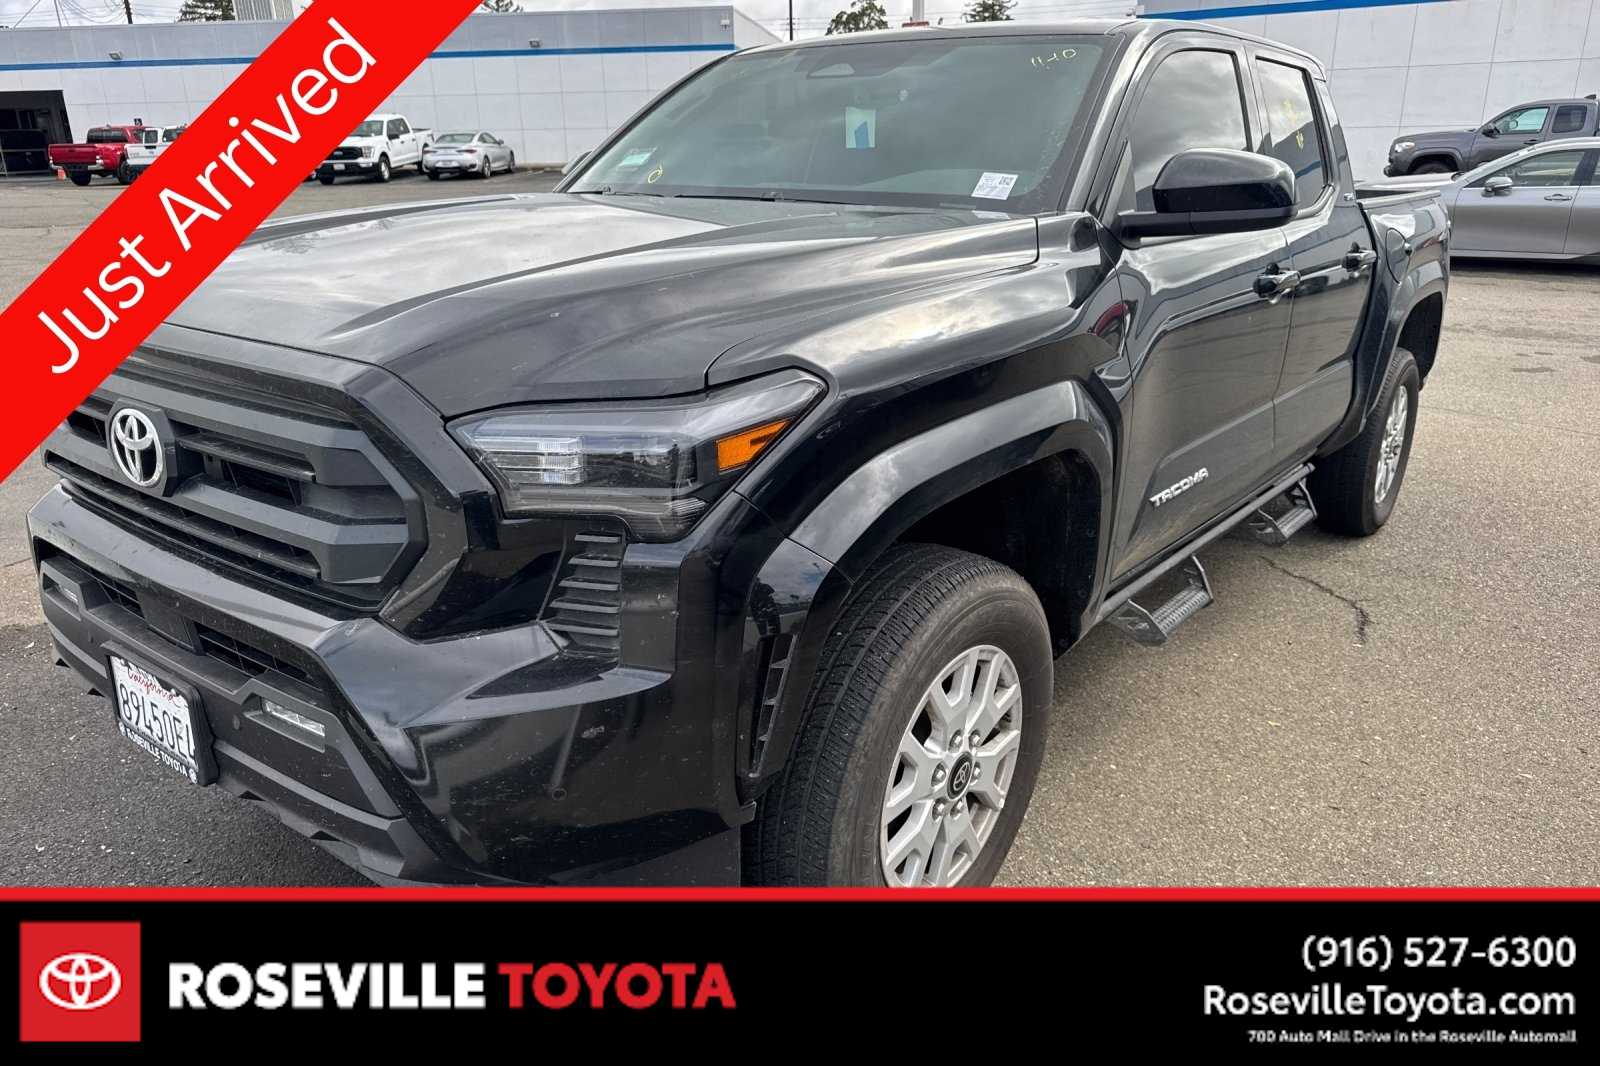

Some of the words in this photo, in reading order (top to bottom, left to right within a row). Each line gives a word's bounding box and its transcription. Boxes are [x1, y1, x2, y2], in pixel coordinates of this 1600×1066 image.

[1150, 467, 1209, 507] TACOMA
[127, 727, 161, 760] ROSEVILLE
[160, 750, 188, 777] TOYOTA
